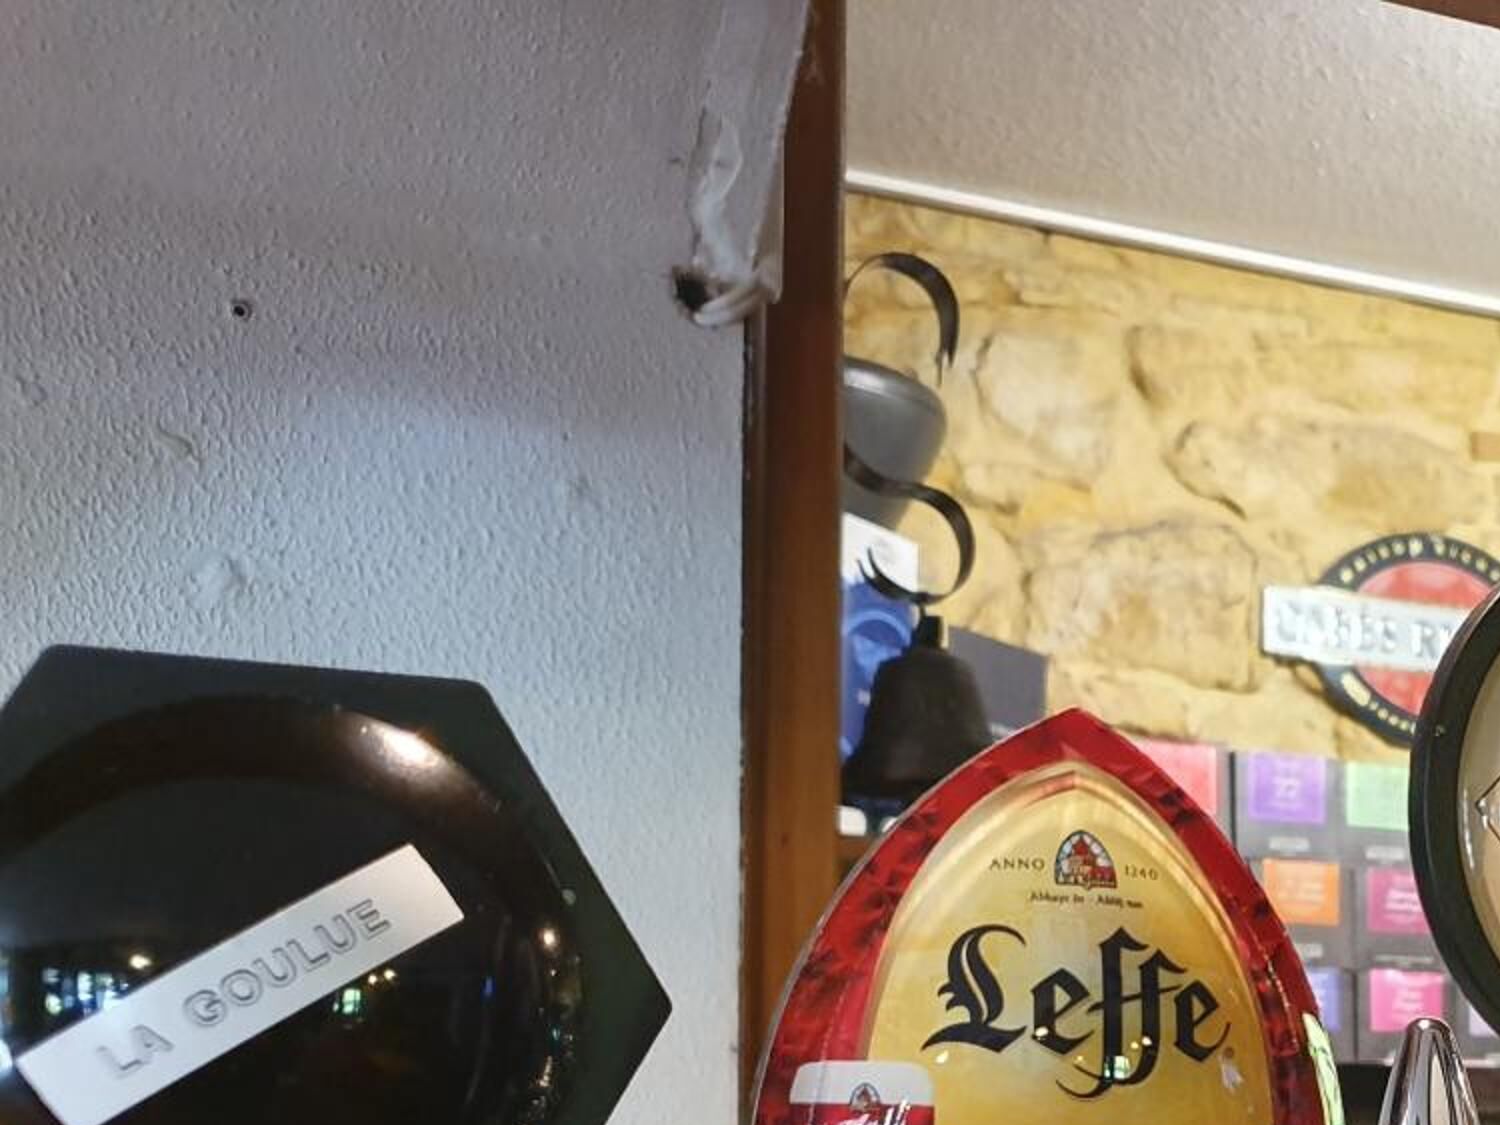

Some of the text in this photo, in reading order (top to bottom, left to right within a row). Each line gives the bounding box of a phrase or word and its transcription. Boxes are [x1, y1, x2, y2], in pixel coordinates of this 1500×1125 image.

[988, 857, 1159, 882] ANNO 1240
[97, 897, 393, 1079] LA GOULUE
[921, 924, 1232, 1101] Leffe
